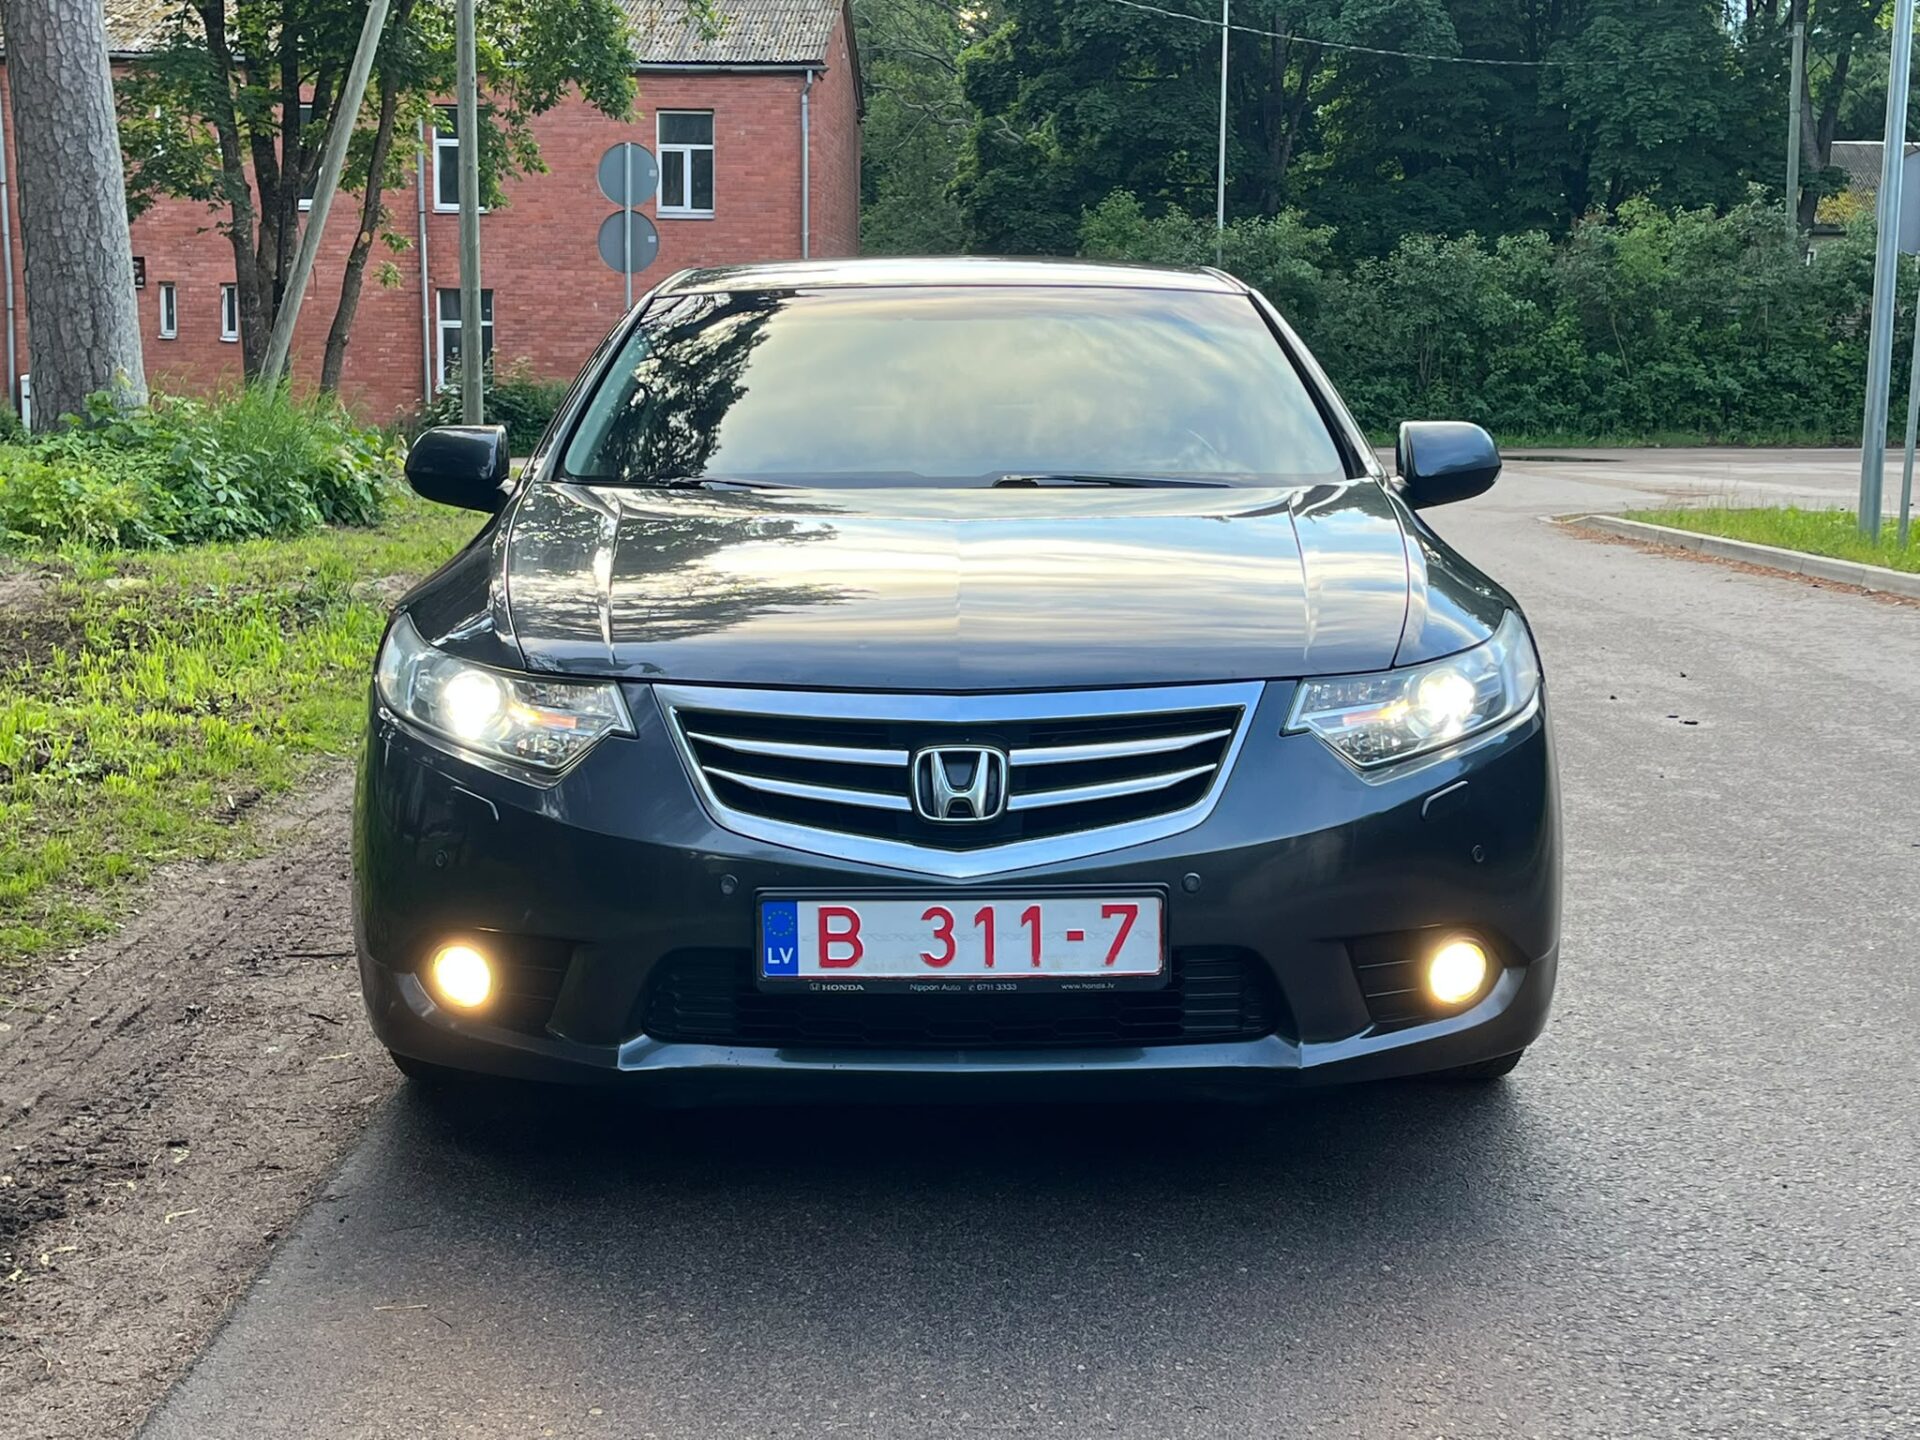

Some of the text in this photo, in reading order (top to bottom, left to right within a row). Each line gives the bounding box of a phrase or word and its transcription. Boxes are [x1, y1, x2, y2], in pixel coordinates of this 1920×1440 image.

[818, 904, 1139, 968] B 311-7
[767, 947, 794, 964] LV
[910, 983, 961, 992] Nippon Auto
